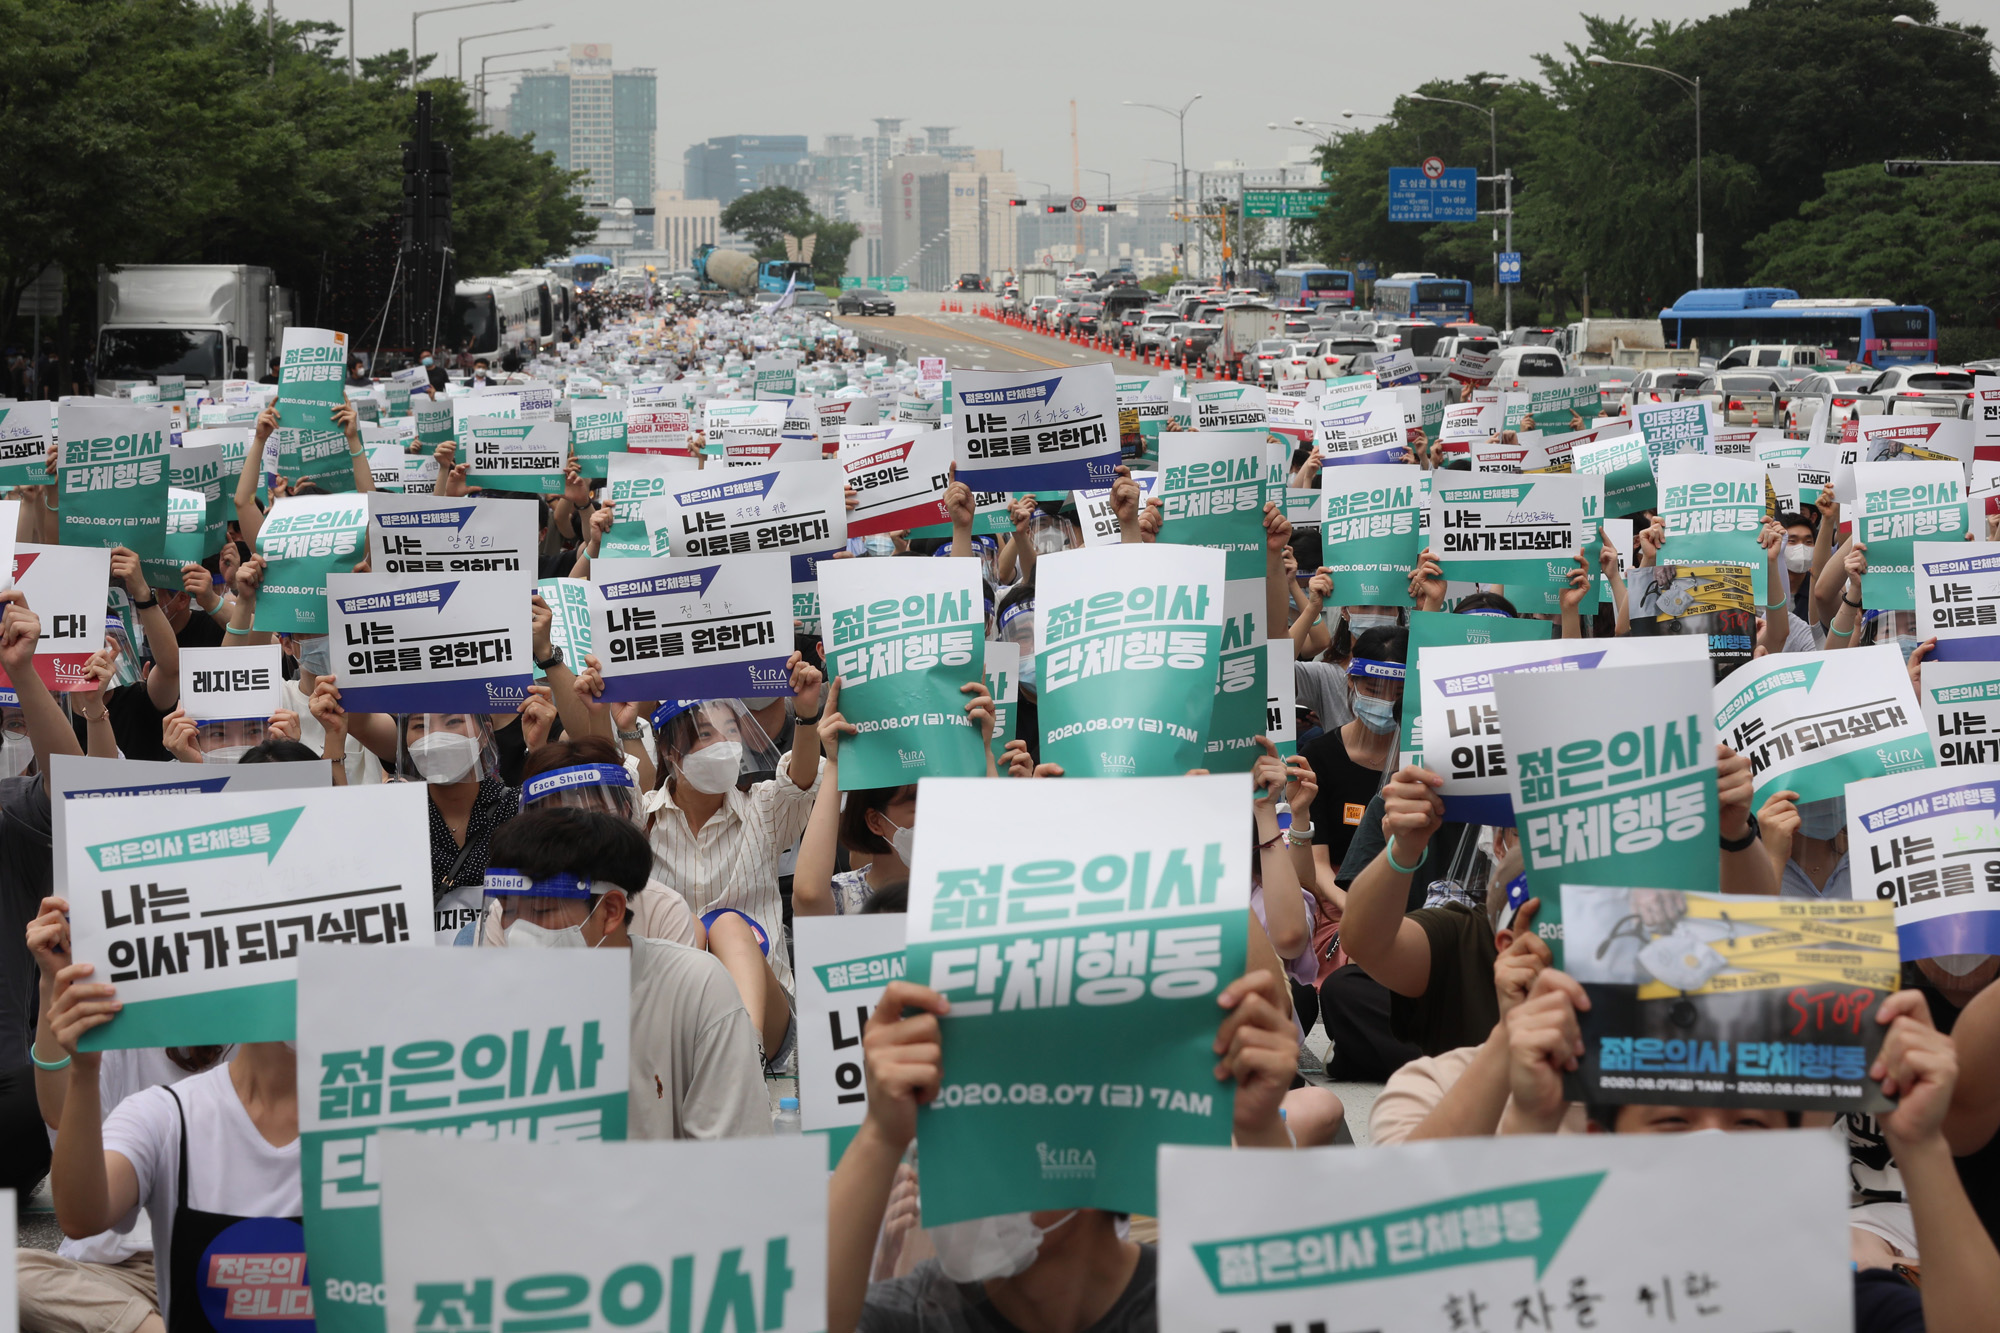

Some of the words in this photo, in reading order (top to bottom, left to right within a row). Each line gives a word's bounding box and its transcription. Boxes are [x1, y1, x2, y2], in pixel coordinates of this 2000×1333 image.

[1906, 320, 1922, 329] 160
[285, 347, 343, 365] 젊은의사
[282, 365, 343, 384] 단체행동
[757, 369, 793, 380] 젊은의사
[280, 398, 316, 406] 2020.08.07
[965, 391, 1004, 404] 젊은의사
[1006, 384, 1047, 400] 단체행동
[1531, 389, 1570, 403] 젊은의사
[417, 408, 451, 421] 젊은의사
[576, 411, 623, 430] 젊은의사
[1199, 404, 1219, 415] 나는
[1199, 415, 1228, 427] 의사가
[1643, 406, 1700, 428] 의료환경
[576, 424, 624, 443] 단체행동
[820, 416, 846, 428] 전공의는
[966, 411, 1007, 433] 나는
[1446, 417, 1477, 430] 전공의는
[1648, 422, 1704, 443] 고려없는
[66, 431, 162, 464] 젊은의사
[968, 433, 1031, 460] 의료를
[1037, 422, 1107, 454] 원한다!
[1325, 429, 1346, 444] 나는
[1327, 440, 1359, 459] 의료를
[1361, 431, 1398, 452] 원한다!
[475, 443, 499, 458] 나는
[847, 458, 874, 475] 젊은의사
[875, 448, 904, 464] 단체행동
[1579, 441, 1640, 468] 젊은의사
[1715, 444, 1750, 455] 전공의는
[66, 459, 162, 494] 단체행동
[475, 458, 509, 474] 의사가
[511, 457, 560, 473] 되고싶다!
[1165, 456, 1258, 496] 젊은의사
[544, 479, 561, 488] KIRA
[848, 466, 909, 493] 전공의는
[680, 490, 722, 506] 젊은의사
[723, 479, 765, 496] 단체행동
[1163, 484, 1259, 521] 단체행동
[1328, 485, 1411, 519] 젊은의사
[1445, 491, 1482, 504] 젊은의사
[1484, 488, 1519, 501] 단체행동
[1664, 482, 1758, 509] 젊은의사
[1865, 481, 1958, 515] 젊은의사
[66, 516, 121, 526] 2020.08.07
[124, 516, 138, 527] (금)
[140, 516, 160, 526] 7AM
[271, 508, 364, 536] 젊은의사
[381, 513, 418, 526] 젊은의사
[421, 512, 460, 524] 단체행동
[682, 511, 727, 534] 나는
[991, 517, 1010, 528] KIRA
[1328, 512, 1412, 546] 단체행동
[1443, 510, 1480, 528] 나는
[1664, 508, 1758, 537] 단체행동
[1867, 508, 1961, 543] 단체행동
[262, 530, 358, 562] 단체행동
[383, 535, 422, 555] 나는
[756, 518, 830, 550] 원한다!
[1443, 532, 1496, 552] 의사가
[1499, 531, 1571, 551] 되고싶다!
[1238, 543, 1258, 551] 7AM
[1329, 563, 1377, 574] 2020.08.07
[1379, 563, 1391, 573] (금)
[1393, 563, 1410, 573] 7AM
[1929, 561, 1969, 575] 젊은의사
[262, 585, 314, 596] 2020.08.07
[606, 584, 653, 599] 젊은의사
[655, 573, 702, 592] 단체행동
[1362, 585, 1379, 593] KIRA
[1929, 583, 1973, 604] 나는
[344, 597, 391, 612] 젊은의사
[393, 589, 441, 606] 단체행동
[53, 614, 87, 639] 다!
[298, 611, 316, 621] KIRA
[606, 607, 656, 632] 나는
[832, 589, 972, 648] 젊은의사
[1046, 585, 1210, 646] 젊은의사
[1720, 611, 1750, 632] STOP
[1932, 605, 1997, 629] 의료를
[344, 622, 395, 646] 나는
[609, 634, 683, 664] 의료를
[690, 620, 775, 654] 원한다!
[347, 651, 422, 676] 의료를
[429, 646, 512, 670] 원한다!
[836, 631, 974, 690] 단체행동
[1046, 631, 1208, 693] 단체행동
[1370, 667, 1387, 677] Face
[1389, 669, 1405, 678] Shi
[192, 669, 270, 693] 레지던트
[756, 669, 788, 684] KIRA
[495, 687, 525, 698] KIRA
[1717, 693, 1757, 724] 젊은의사
[1757, 670, 1806, 694] 단체행동
[1938, 685, 1984, 702] 젊은의사
[922, 713, 945, 732] (금)
[1048, 717, 1133, 744] 2020.08.07
[1138, 718, 1163, 740] (금)
[1166, 725, 1197, 744] 7AM
[1799, 706, 1908, 757] 되고싶다!
[1938, 711, 1987, 737] 나는
[1103, 755, 1135, 771] KIRA
[1517, 715, 1701, 805] 젊은의사
[1883, 748, 1923, 766] KIRA
[533, 780, 556, 794] Face
[559, 771, 595, 787] Shield
[1868, 799, 1928, 830] 젊은의사
[1931, 788, 1996, 812] 단체행동
[1526, 781, 1706, 869] 단체행동
[99, 836, 185, 868] 젊은의사
[188, 821, 272, 854] 단체행동
[1870, 836, 1935, 874] 나는
[491, 876, 523, 889] Shield
[931, 842, 1226, 933] 젊은의사
[1876, 863, 1975, 908] 의료를
[102, 883, 190, 930] 나는
[108, 925, 230, 983] 의사가
[930, 924, 1222, 1018] 단체행동
[1788, 988, 1875, 1036] STOP
[1599, 1037, 1731, 1074] 젊은의사
[1736, 1042, 1866, 1079] 단체행동
[319, 1020, 604, 1121] 젊은의사
[931, 1083, 1093, 1109] 2020.08.07
[1100, 1085, 1143, 1107] (금)
[1151, 1089, 1212, 1116] 7AM
[1695, 1079, 1725, 1092] 7AM
[1832, 1085, 1863, 1098] 7AM
[1048, 1148, 1097, 1167] KIRA
[1216, 1226, 1377, 1288] 젊은의사
[1383, 1198, 1543, 1264] 단체행동
[215, 1257, 302, 1284] 전공의
